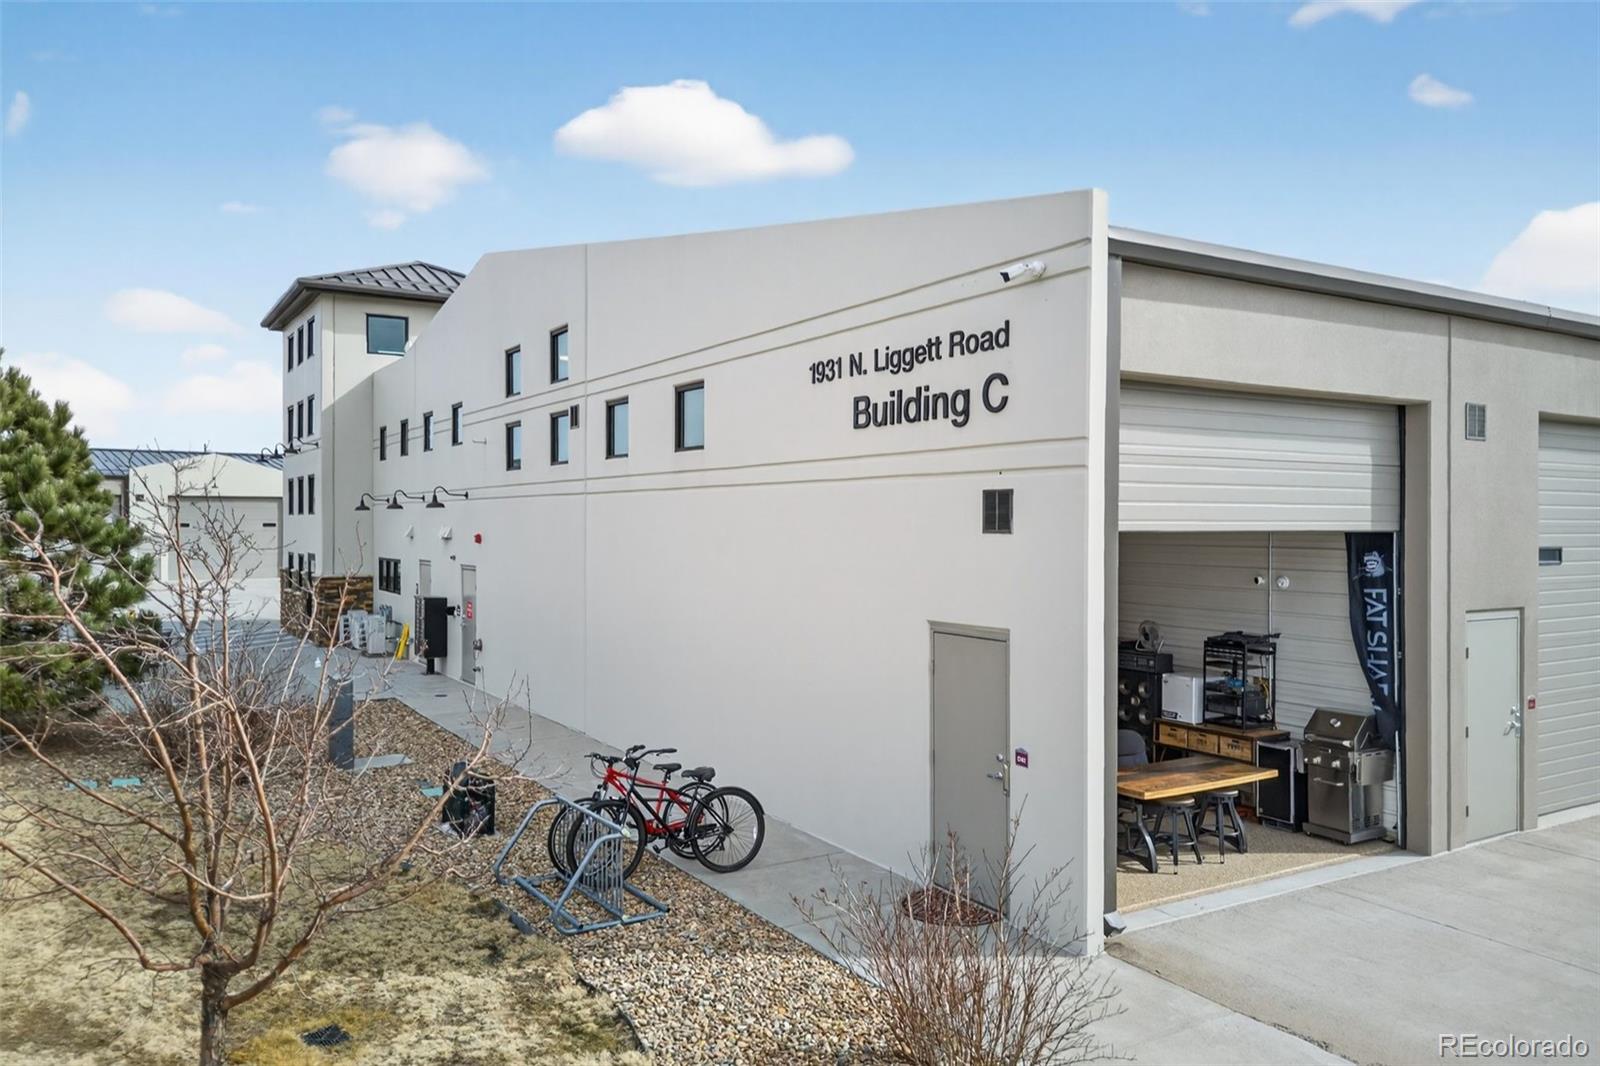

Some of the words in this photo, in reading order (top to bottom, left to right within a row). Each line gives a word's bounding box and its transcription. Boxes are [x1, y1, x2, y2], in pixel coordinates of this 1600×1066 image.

[809, 357, 842, 384] 1931
[850, 352, 867, 377] N.
[874, 336, 942, 374] Liggett
[949, 320, 1010, 357] Road
[853, 385, 971, 429] Building
[982, 373, 1009, 413] C
[1363, 588, 1388, 628] FAT
